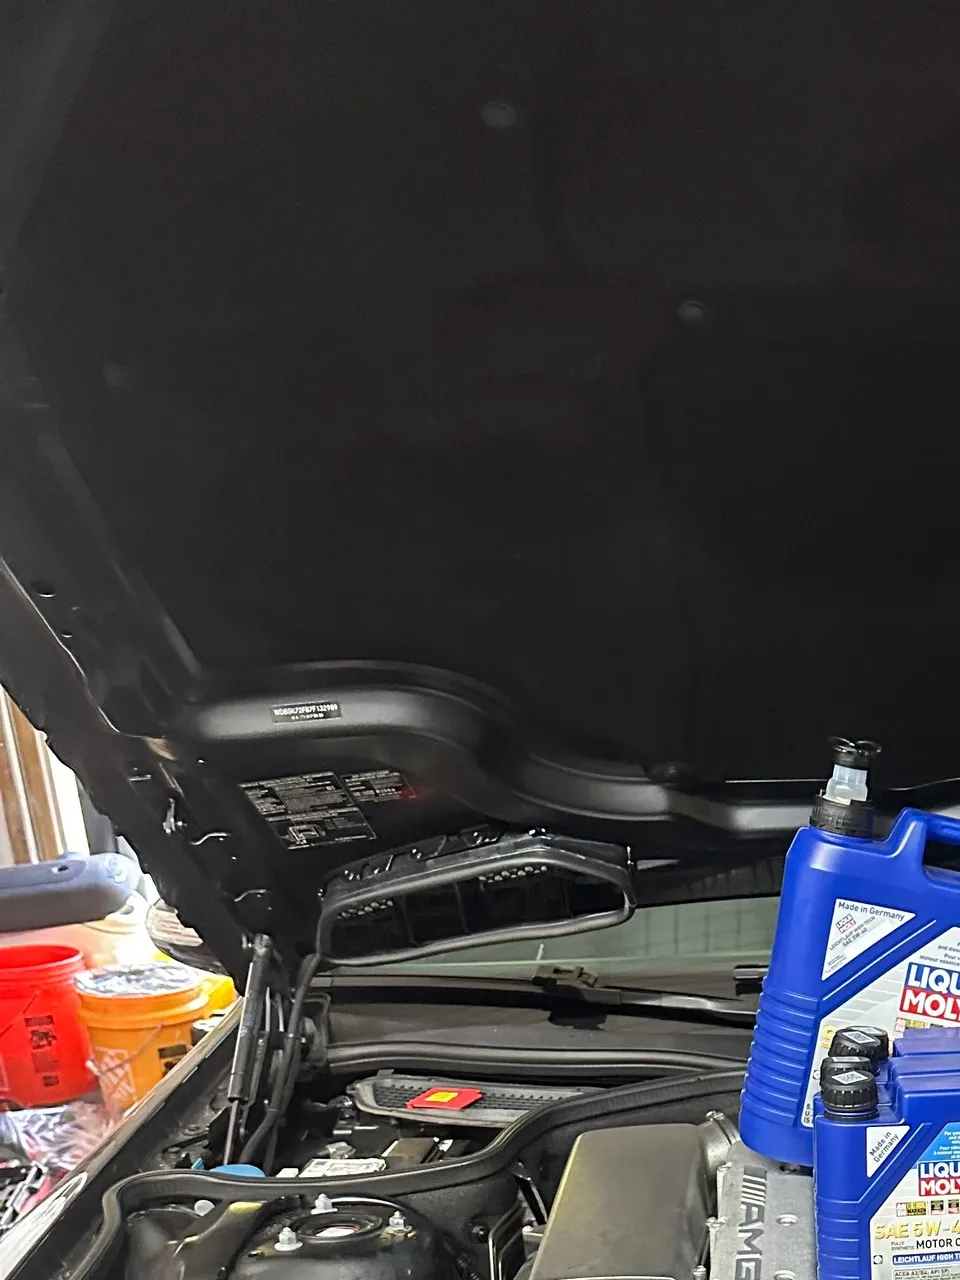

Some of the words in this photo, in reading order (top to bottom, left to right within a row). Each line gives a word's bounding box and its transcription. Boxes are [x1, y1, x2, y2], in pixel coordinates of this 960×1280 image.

[838, 901, 859, 911] Made
[870, 907, 905, 921] Germany
[869, 1139, 886, 1156] Made
[873, 1133, 899, 1163] Germany
[874, 1222, 909, 1239] SAE
[916, 1239, 952, 1249] MOTOR
[894, 1255, 936, 1264] LEICHTLAUF
